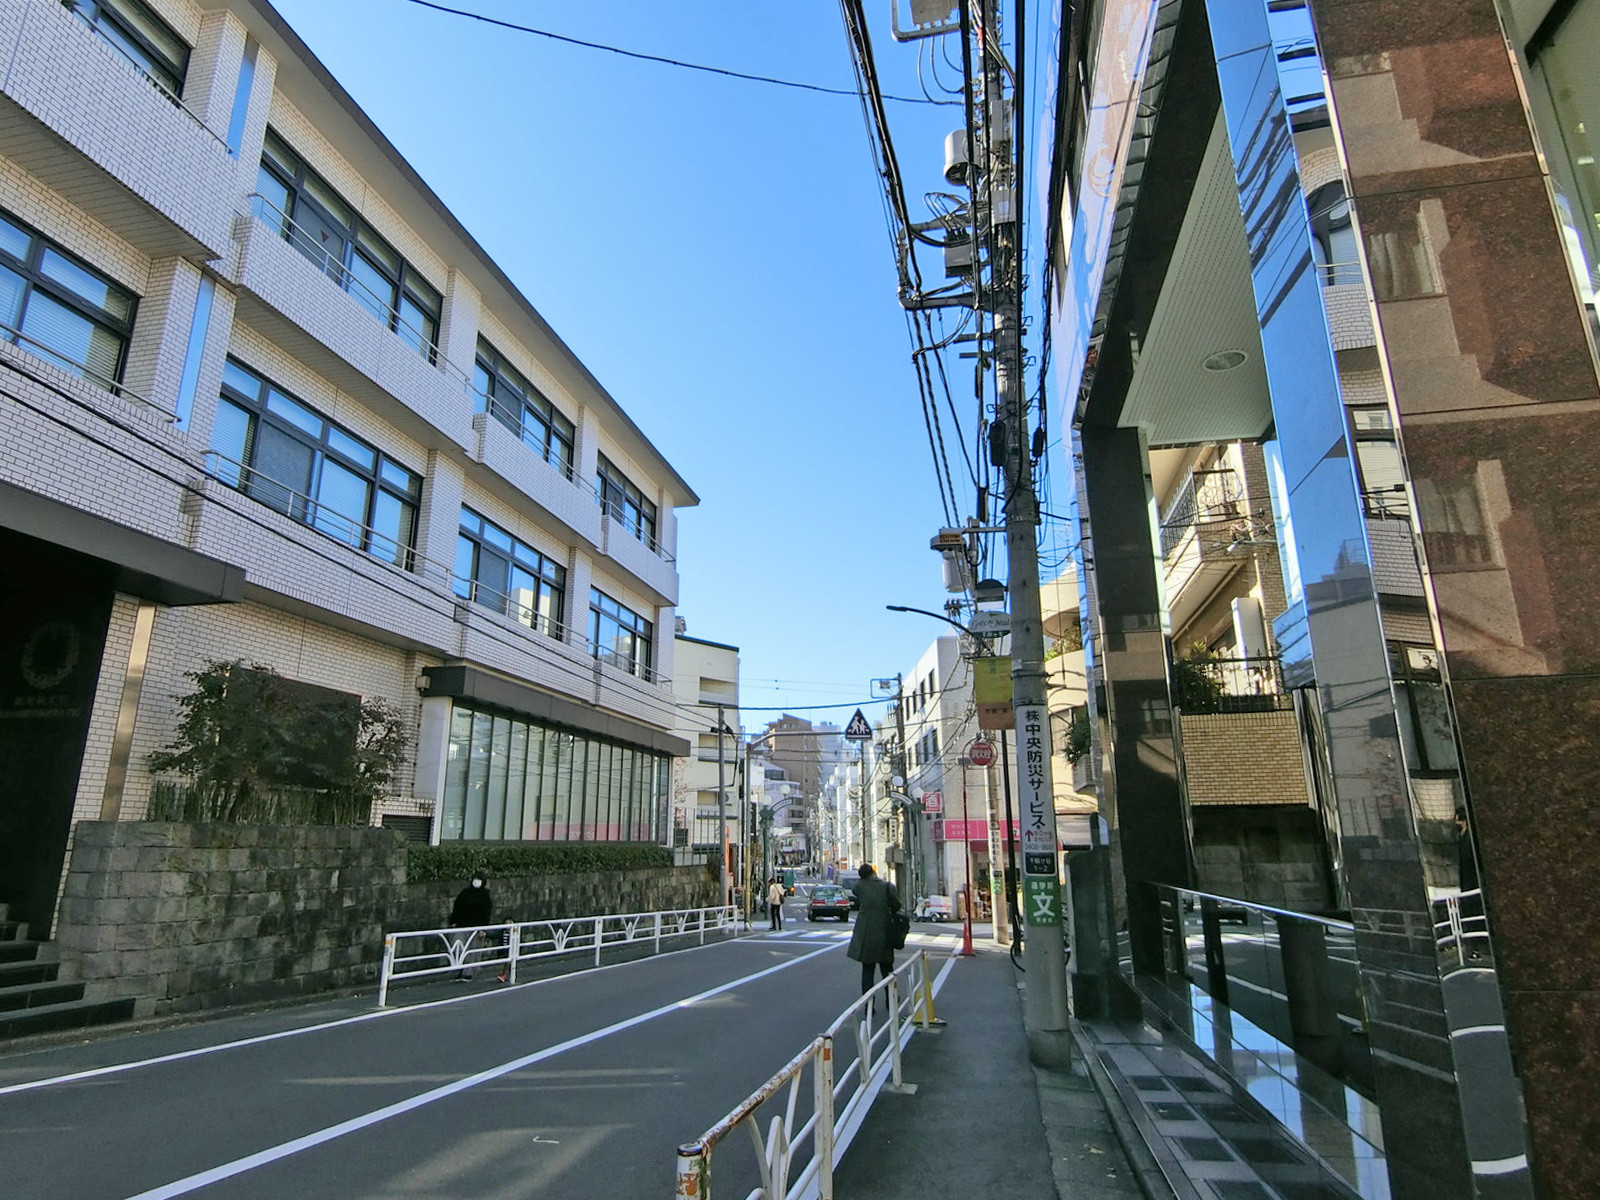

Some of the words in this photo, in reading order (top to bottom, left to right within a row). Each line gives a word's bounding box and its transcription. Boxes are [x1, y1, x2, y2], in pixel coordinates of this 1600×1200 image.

[994, 619, 1010, 627] Mal
[970, 748, 992, 759] 消火栓
[1032, 891, 1055, 917] 文
